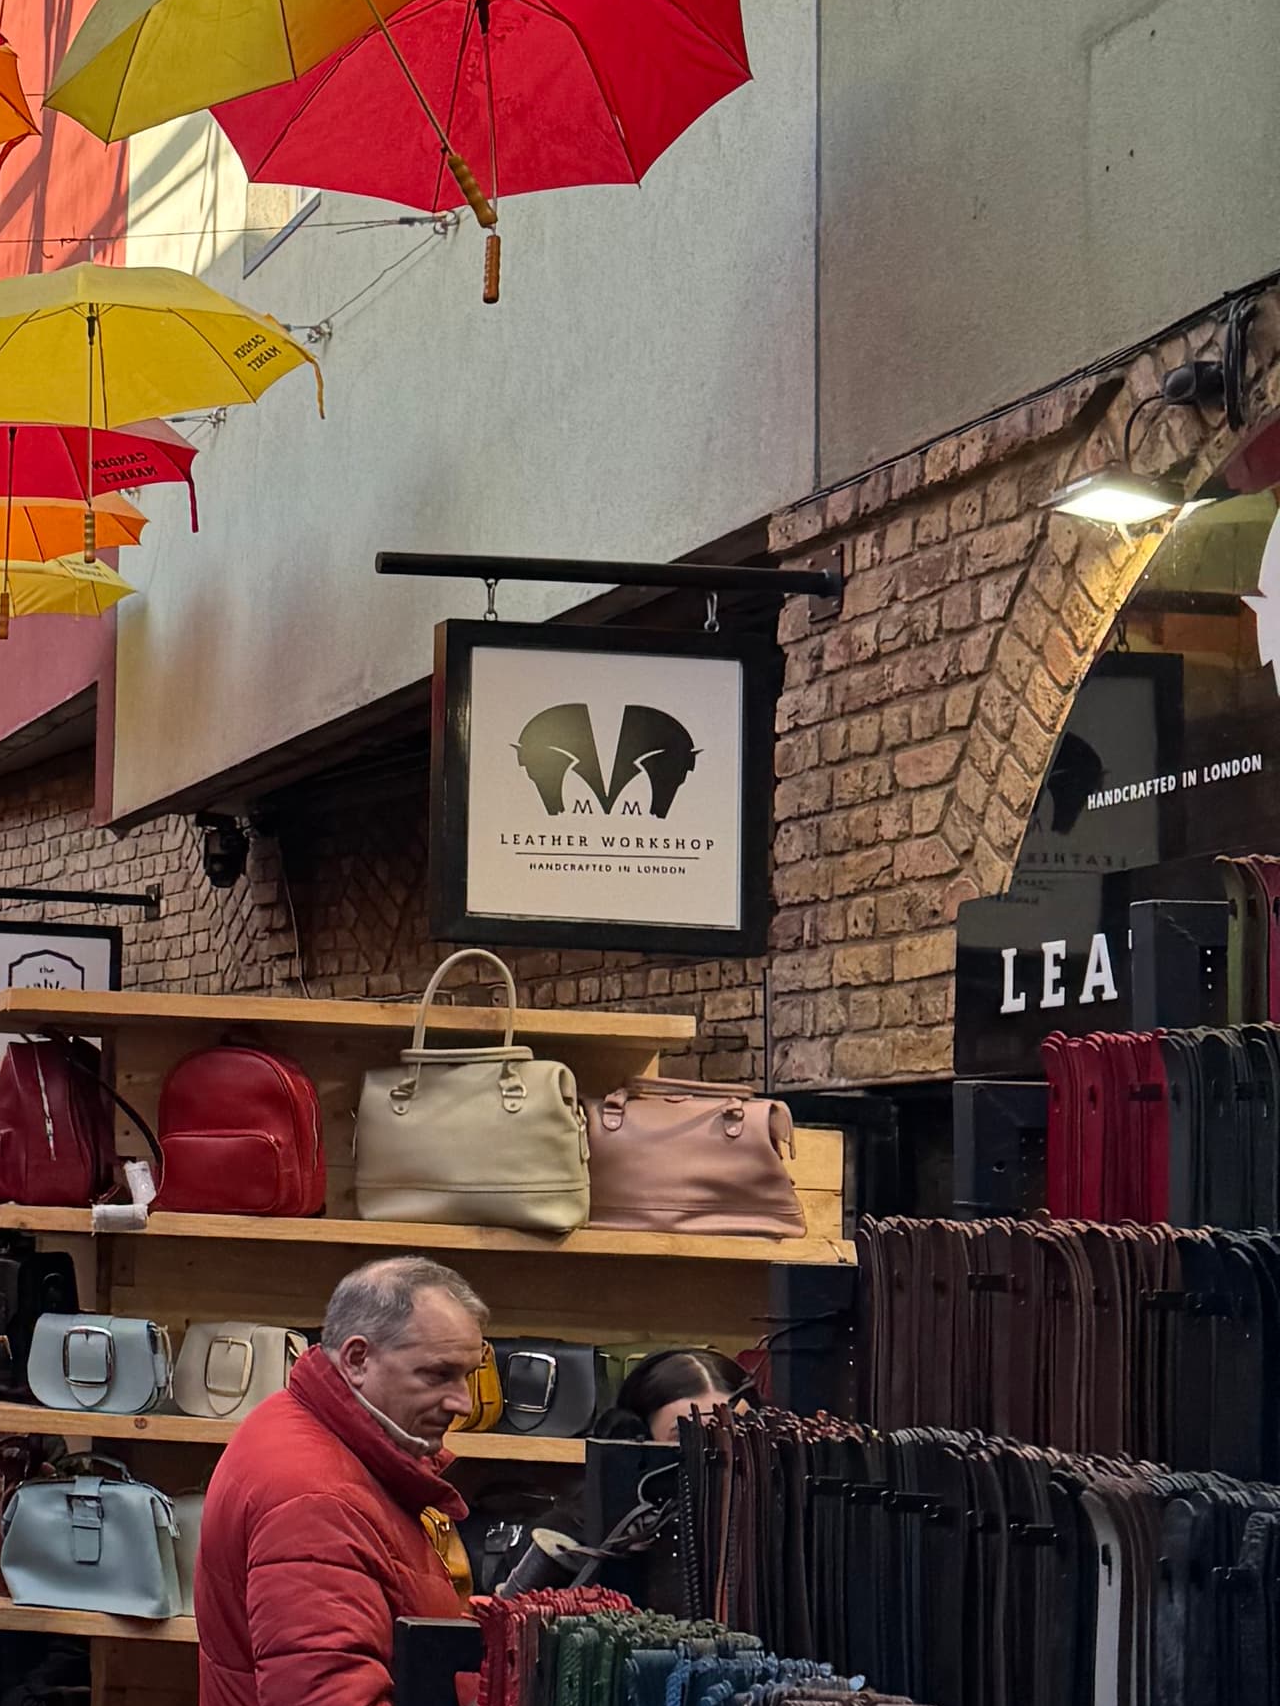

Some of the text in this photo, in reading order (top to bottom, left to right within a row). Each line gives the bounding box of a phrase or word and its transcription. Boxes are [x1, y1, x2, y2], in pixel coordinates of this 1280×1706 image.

[1087, 754, 1263, 810] HANDCRAFTED IN LONDON
[501, 834, 715, 850] LEATHER WORKSHOP
[529, 863, 686, 875] HANDCRAFTED IN LONDON
[1000, 931, 1132, 1014] LEA
